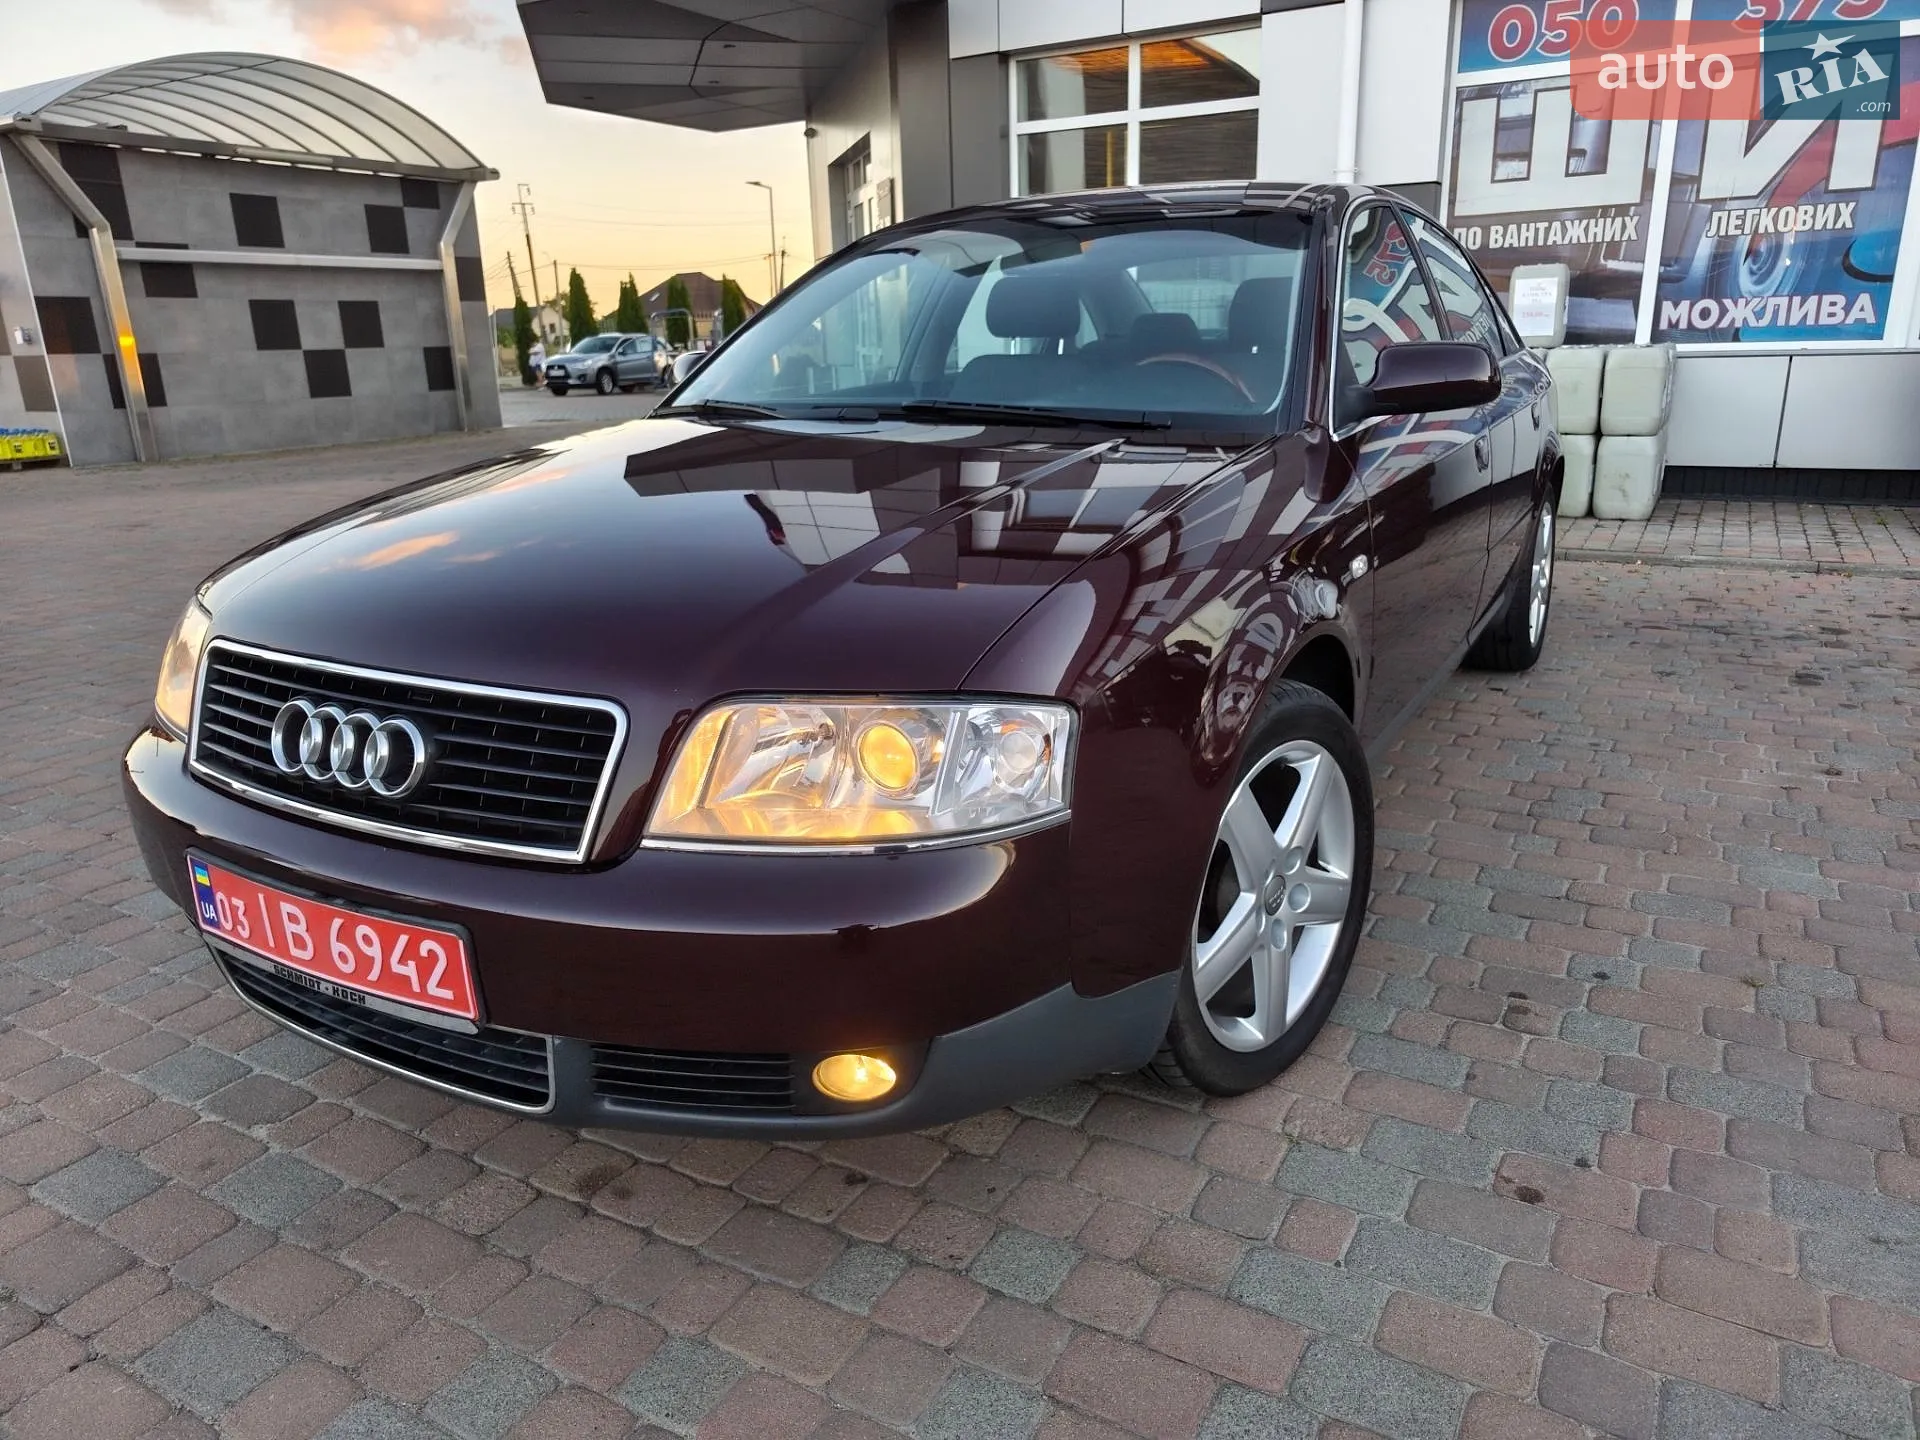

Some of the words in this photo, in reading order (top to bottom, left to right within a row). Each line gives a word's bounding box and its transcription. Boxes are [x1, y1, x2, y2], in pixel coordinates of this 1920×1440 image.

[1488, 0, 1639, 62] 050
[1489, 215, 1641, 250] ВАНТАЖНИХ
[1706, 202, 1857, 238] ЛЕГКОВИХ
[1658, 292, 1877, 331] МОЖЛИВА
[201, 900, 218, 923] UA
[215, 891, 251, 939] 03
[329, 917, 456, 1001] 6942
[273, 964, 322, 992] SCHMIDT
[332, 987, 367, 1005] KOCH
